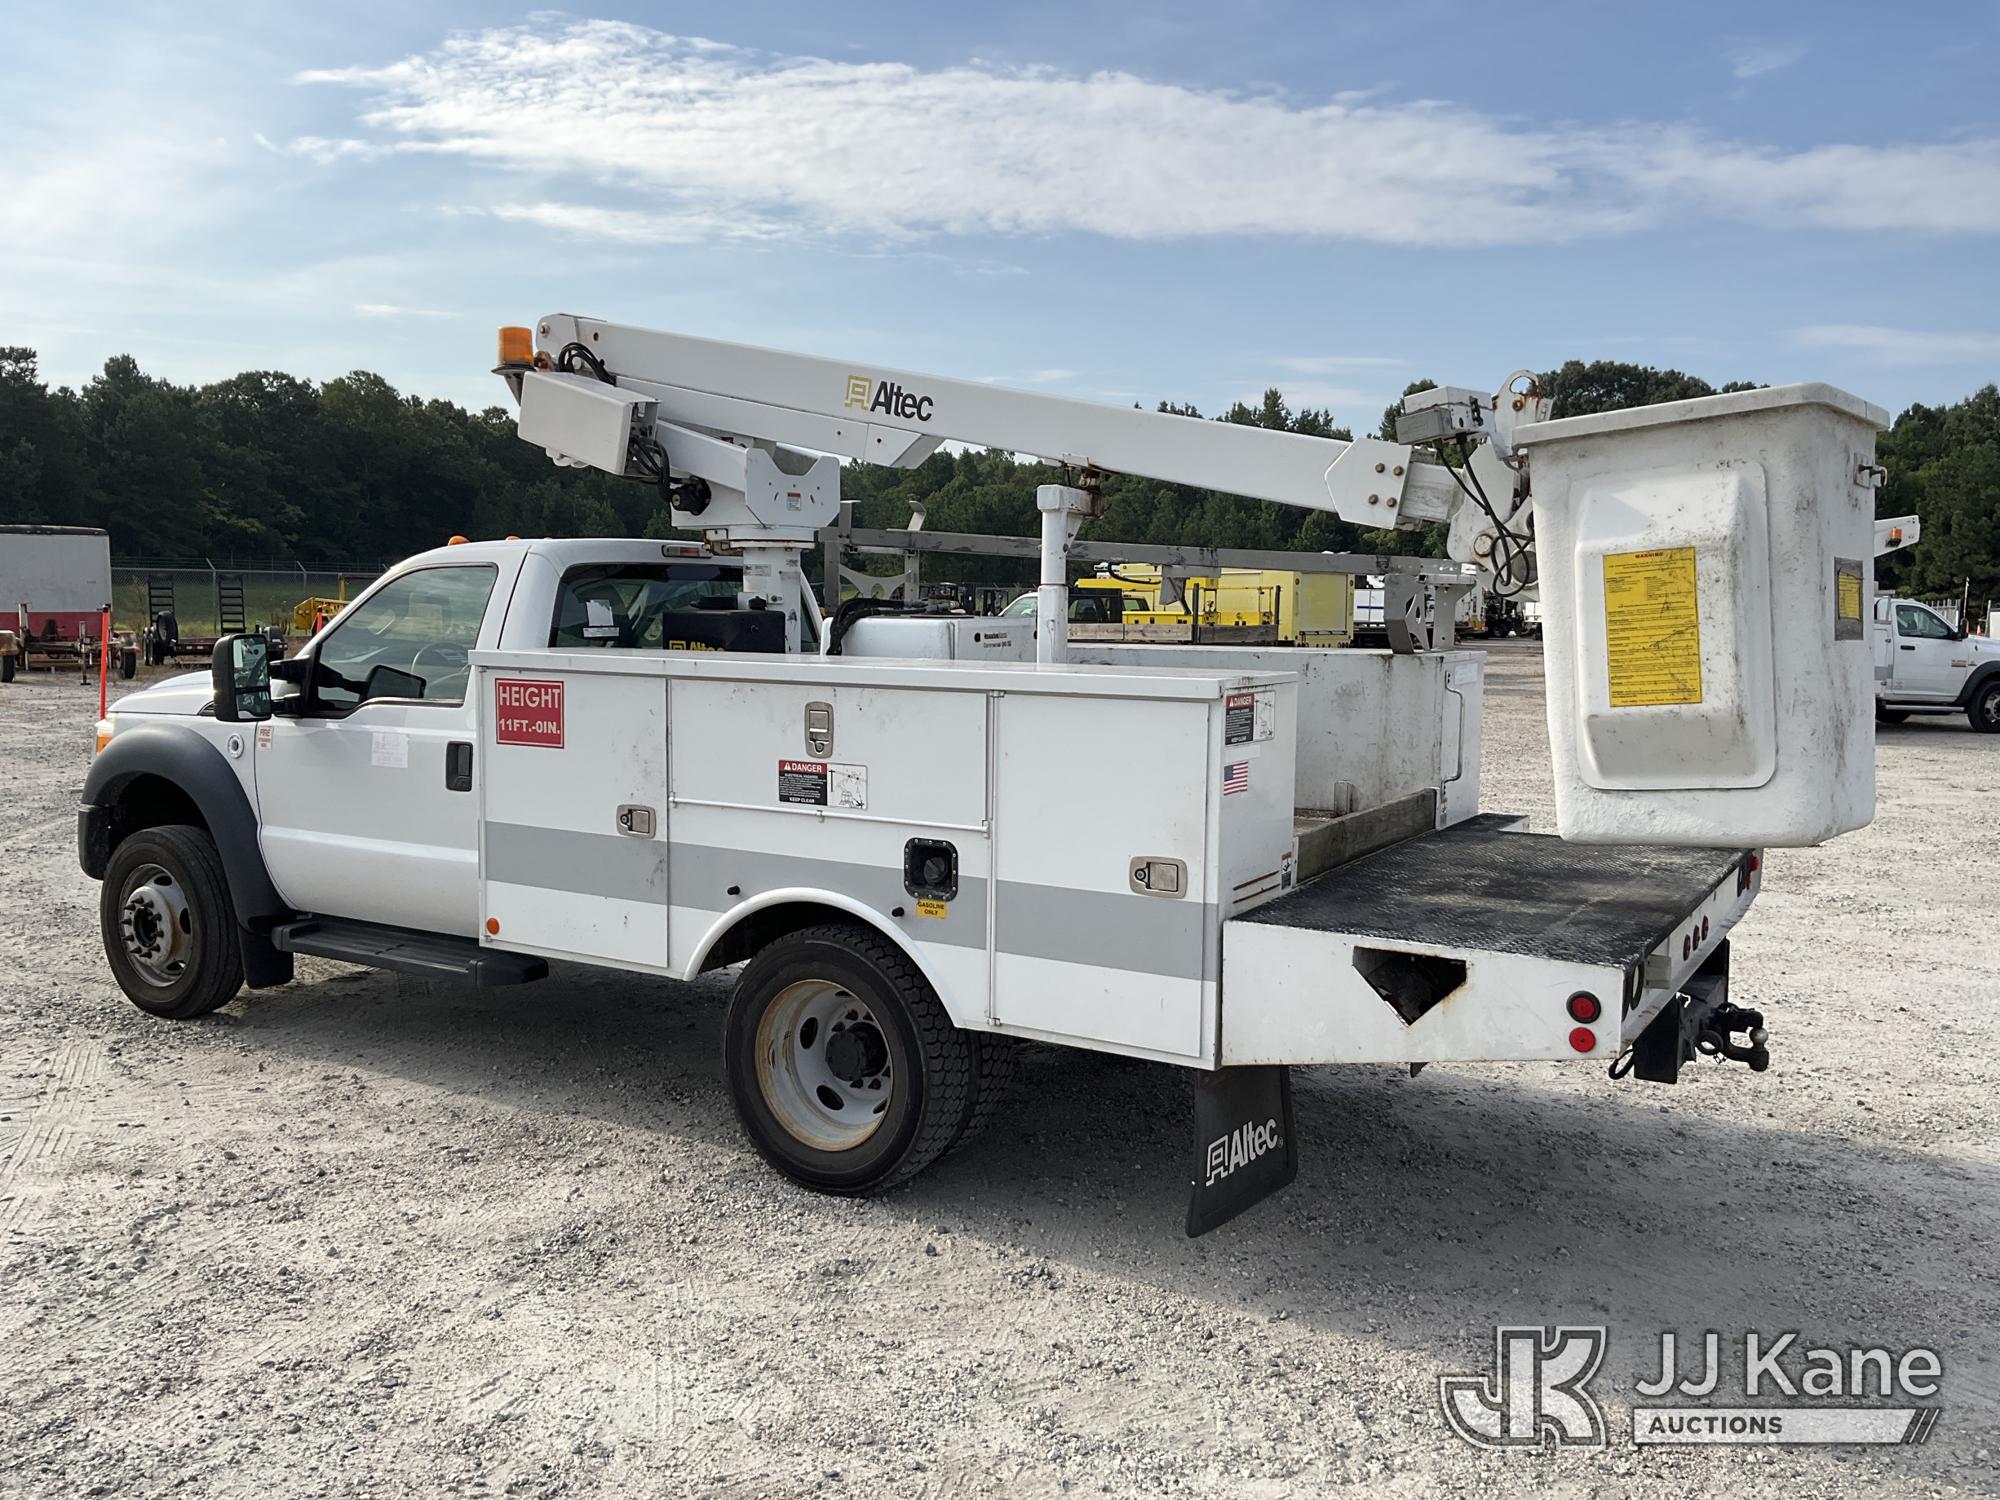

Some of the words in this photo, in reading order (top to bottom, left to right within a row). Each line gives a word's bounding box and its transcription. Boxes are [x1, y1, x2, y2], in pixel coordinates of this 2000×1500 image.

[869, 380, 934, 421] Altec
[499, 686, 561, 708] HEIGHT
[791, 763, 822, 773] DANGER
[917, 901, 945, 910] GASOLINE
[1229, 1118, 1278, 1174] Altec
